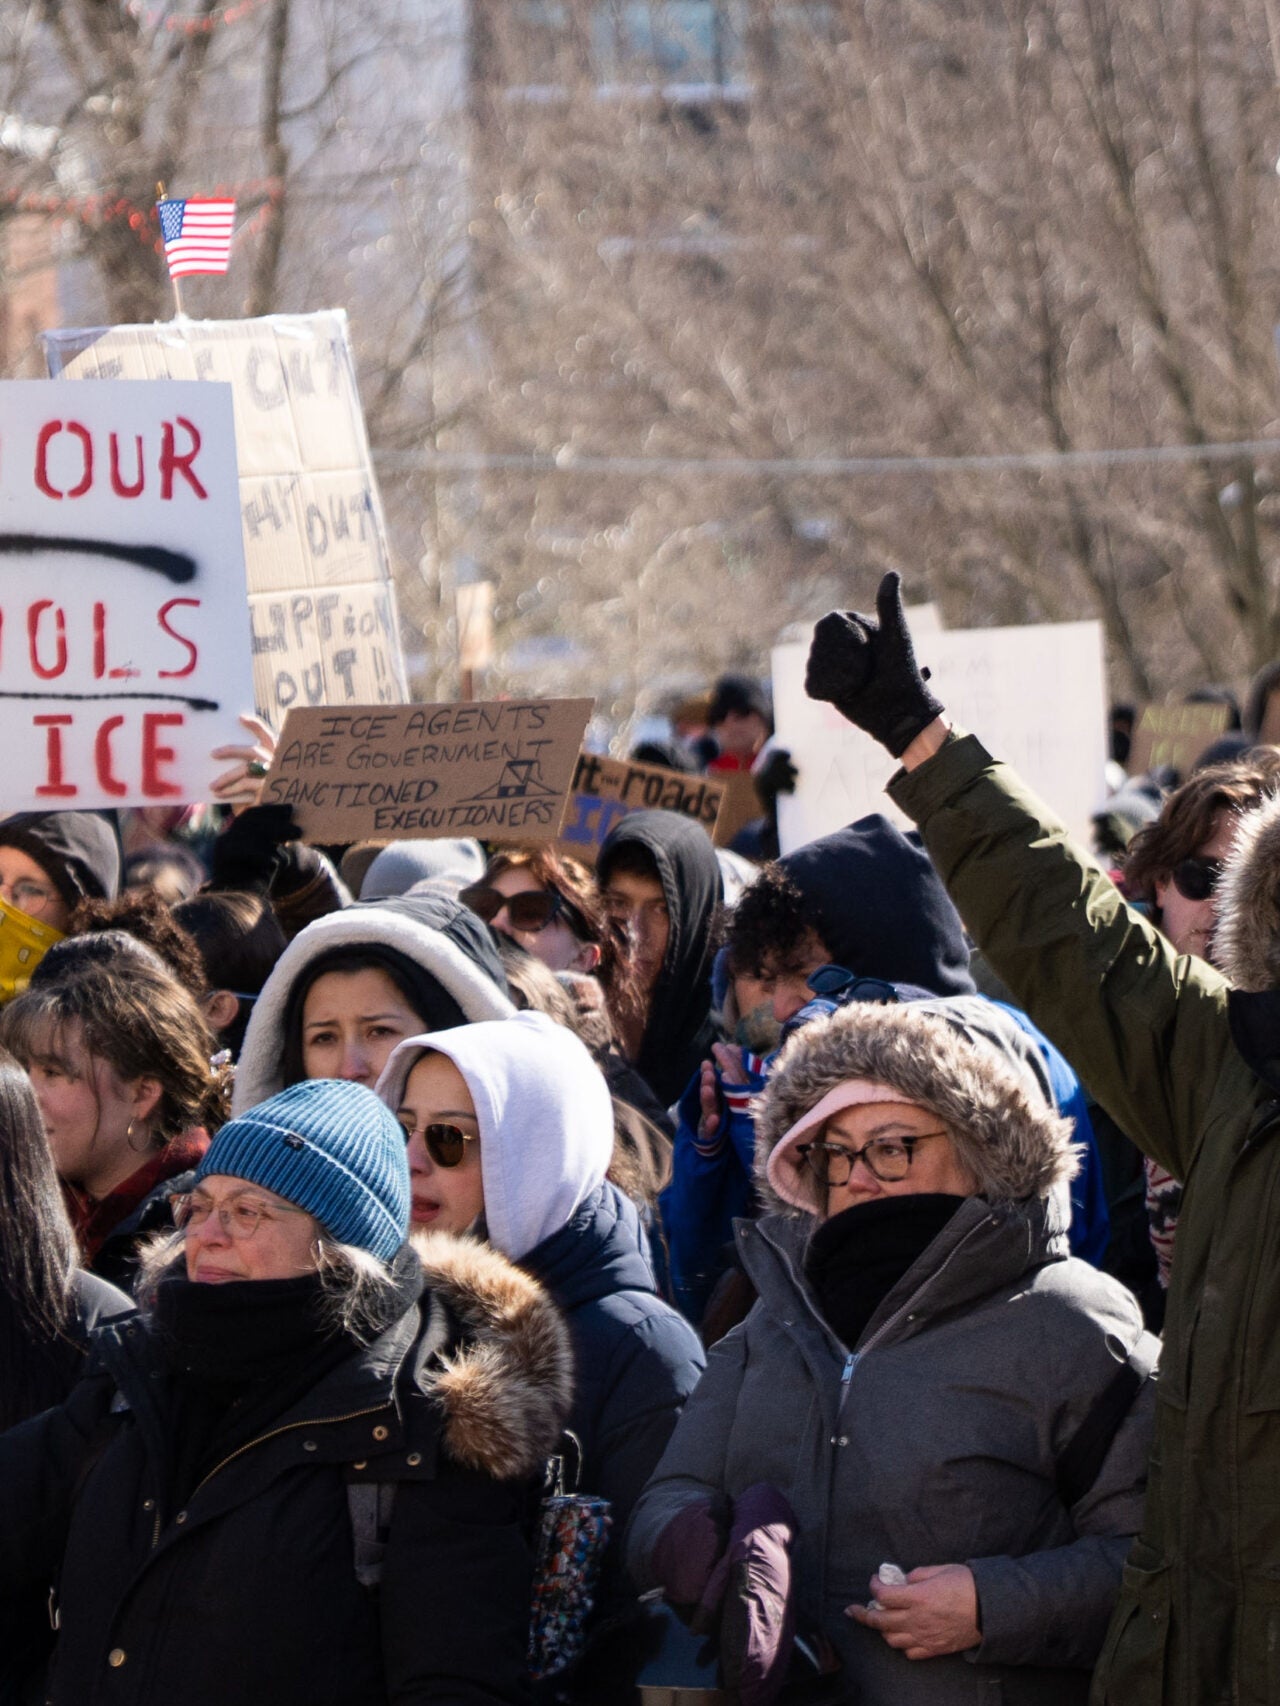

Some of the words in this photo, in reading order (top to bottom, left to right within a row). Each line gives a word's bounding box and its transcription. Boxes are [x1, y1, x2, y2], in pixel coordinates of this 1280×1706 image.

[34, 416, 208, 500] OUR
[0, 598, 202, 680] OLS
[319, 714, 398, 740] ICE
[403, 704, 551, 739] AGENTS
[32, 713, 184, 798] ICE
[279, 740, 335, 771] ARE
[346, 739, 554, 771] GOVERNMENT
[269, 779, 439, 808] SANCTIONED
[373, 801, 556, 831] EXECUTIONERS
[620, 768, 721, 823] roads
